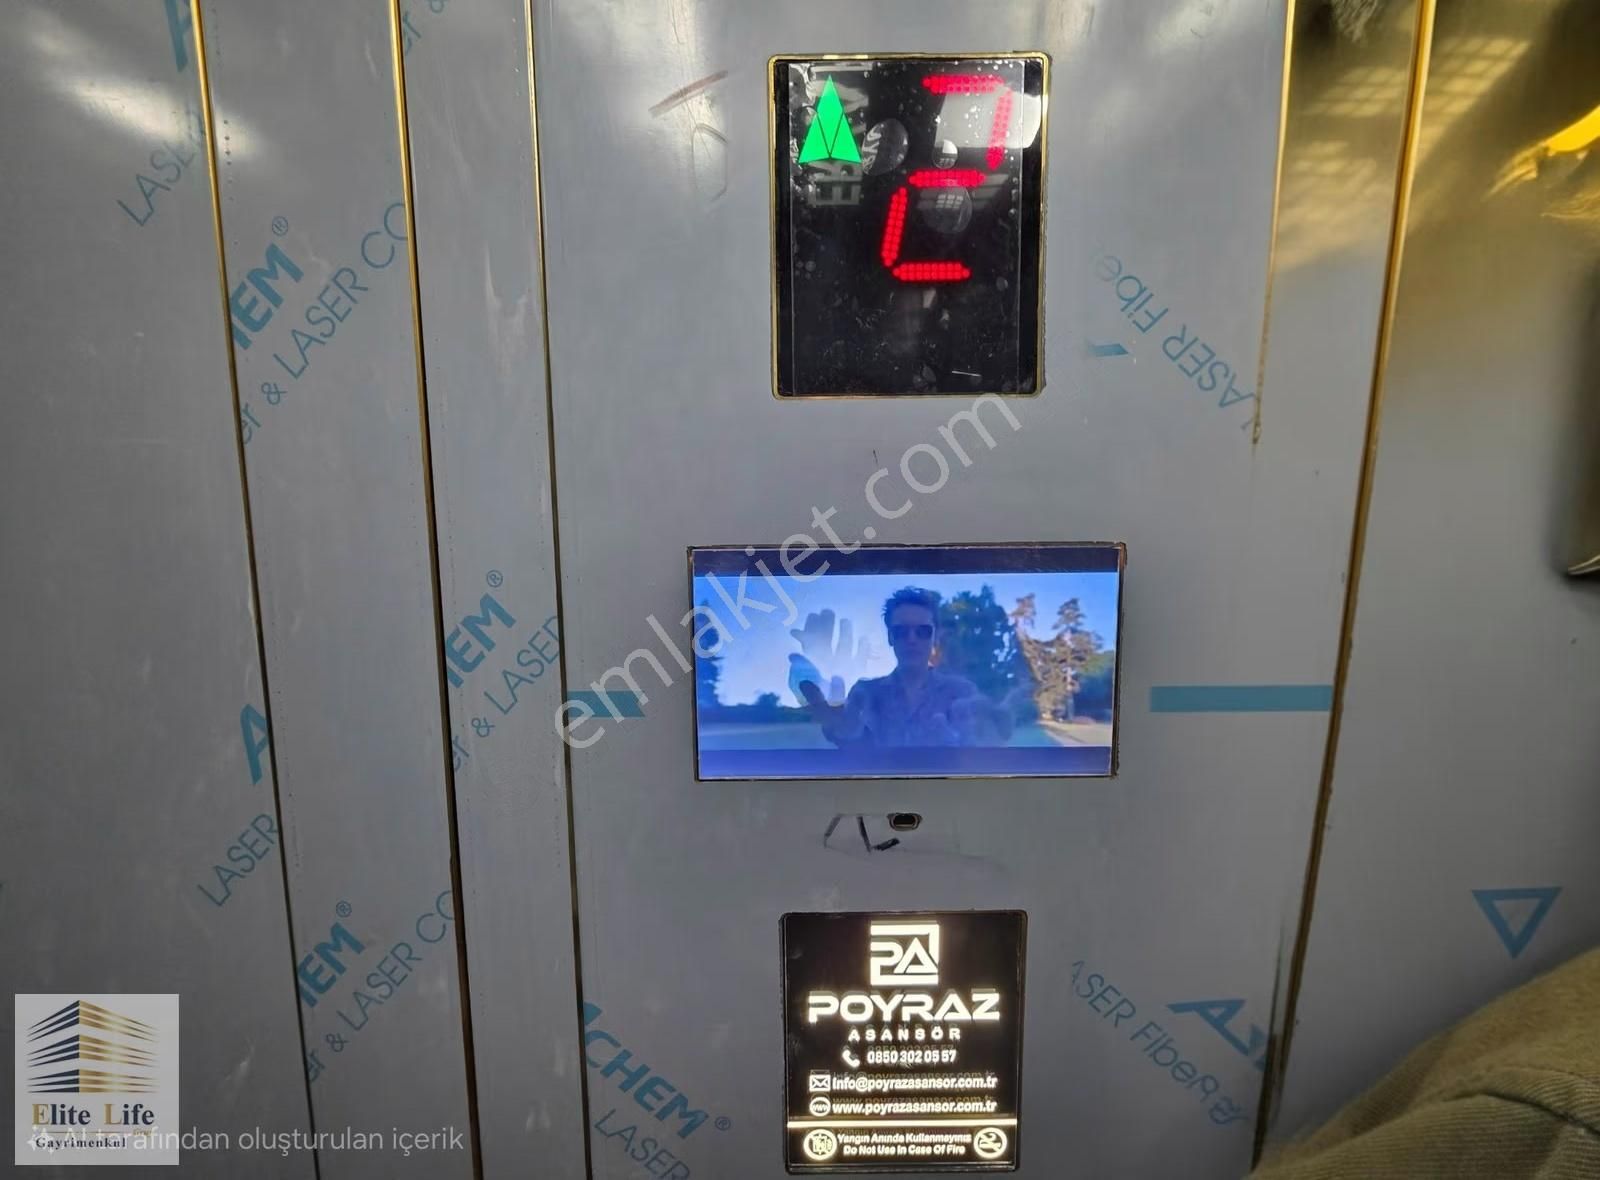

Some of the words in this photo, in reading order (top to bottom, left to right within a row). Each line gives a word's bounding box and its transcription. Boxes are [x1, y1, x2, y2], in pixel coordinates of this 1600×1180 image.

[273, 267, 368, 379] LASER
[336, 942, 423, 1031] LASER
[807, 992, 1001, 1023] POYRAZ
[847, 1026, 961, 1043] ASANSÖR
[899, 1050, 922, 1064] 302
[941, 1049, 957, 1063] 57
[832, 1075, 998, 1092] info@poyrazasansor.com.tr
[832, 1100, 998, 1115] www.poyrazasansor.com.tr
[843, 1144, 858, 1156] Do
[859, 1144, 876, 1155] Not
